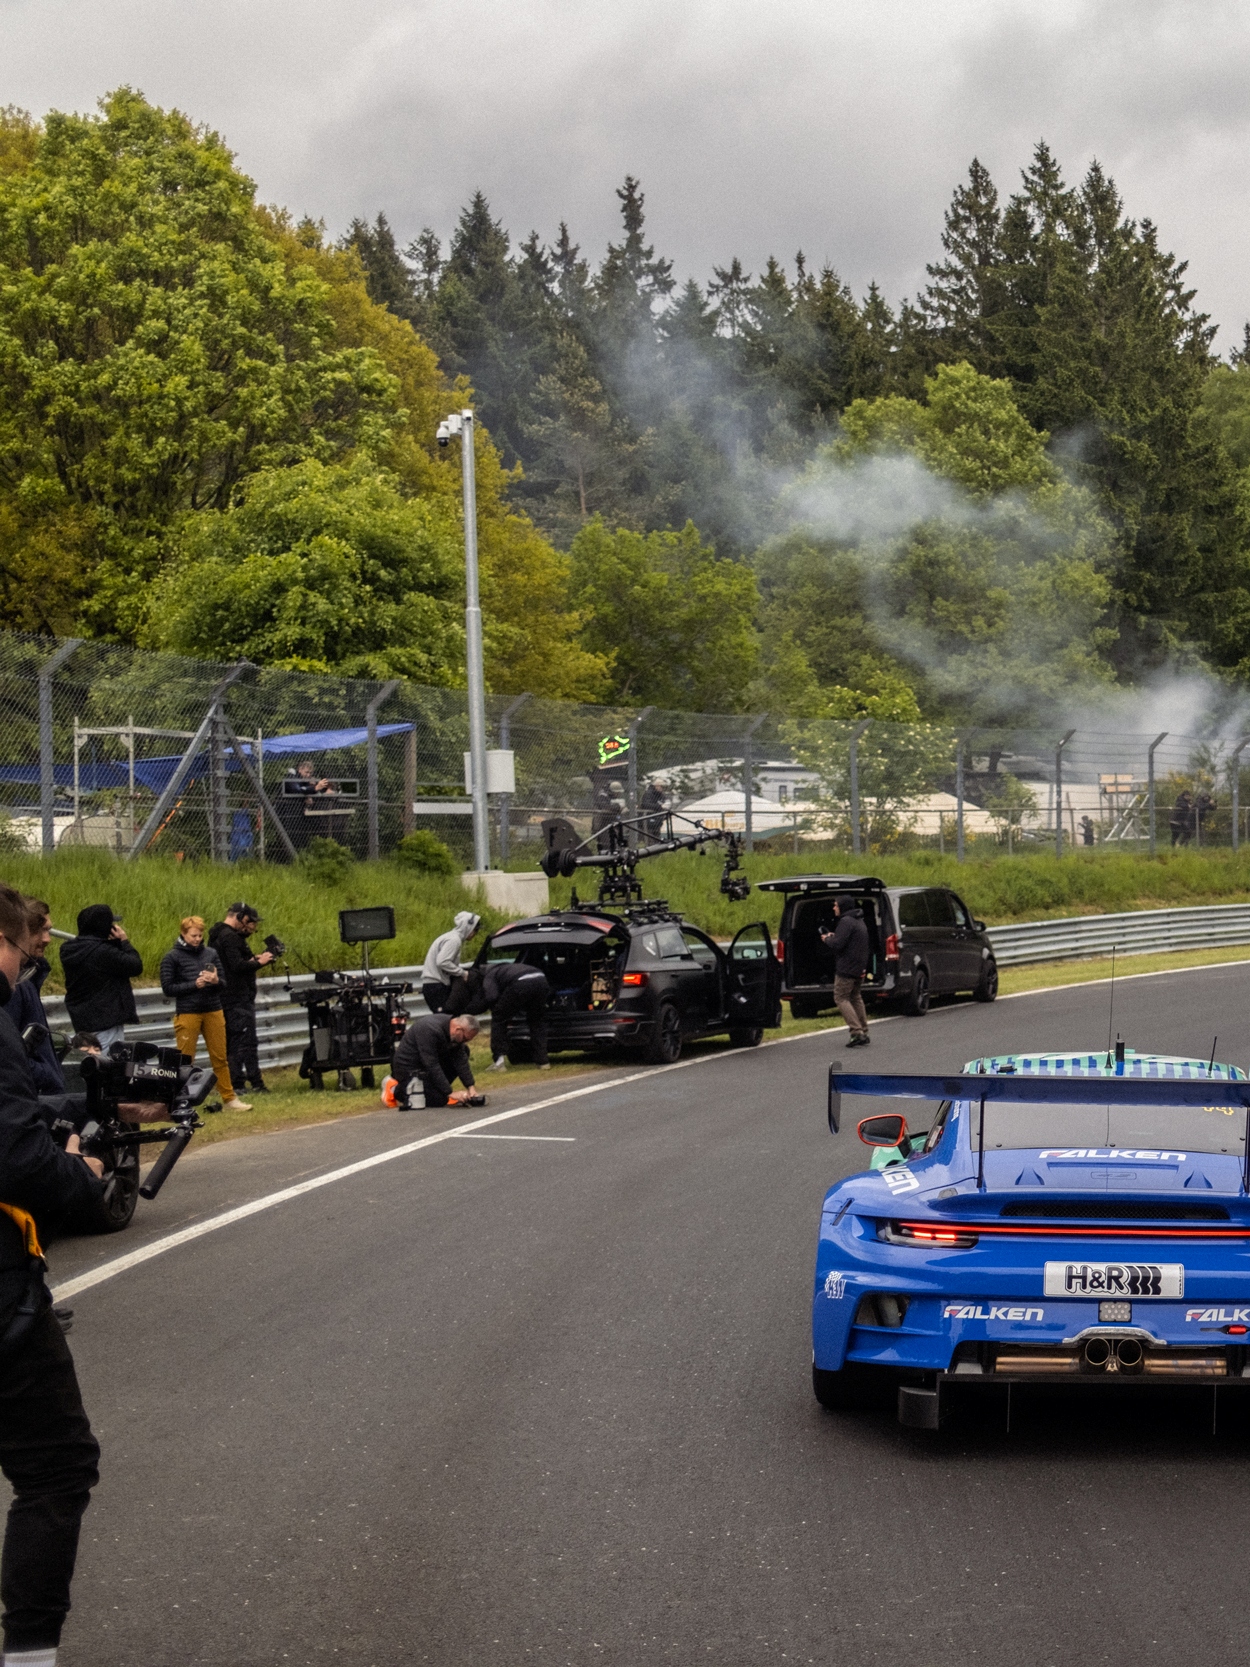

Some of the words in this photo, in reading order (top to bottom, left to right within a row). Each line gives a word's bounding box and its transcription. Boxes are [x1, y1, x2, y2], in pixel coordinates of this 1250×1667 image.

[151, 1068, 177, 1078] RONIN
[1039, 1149, 1187, 1161] FALKEN
[1065, 1264, 1129, 1294] H&R
[943, 1305, 1044, 1321] FALKEN
